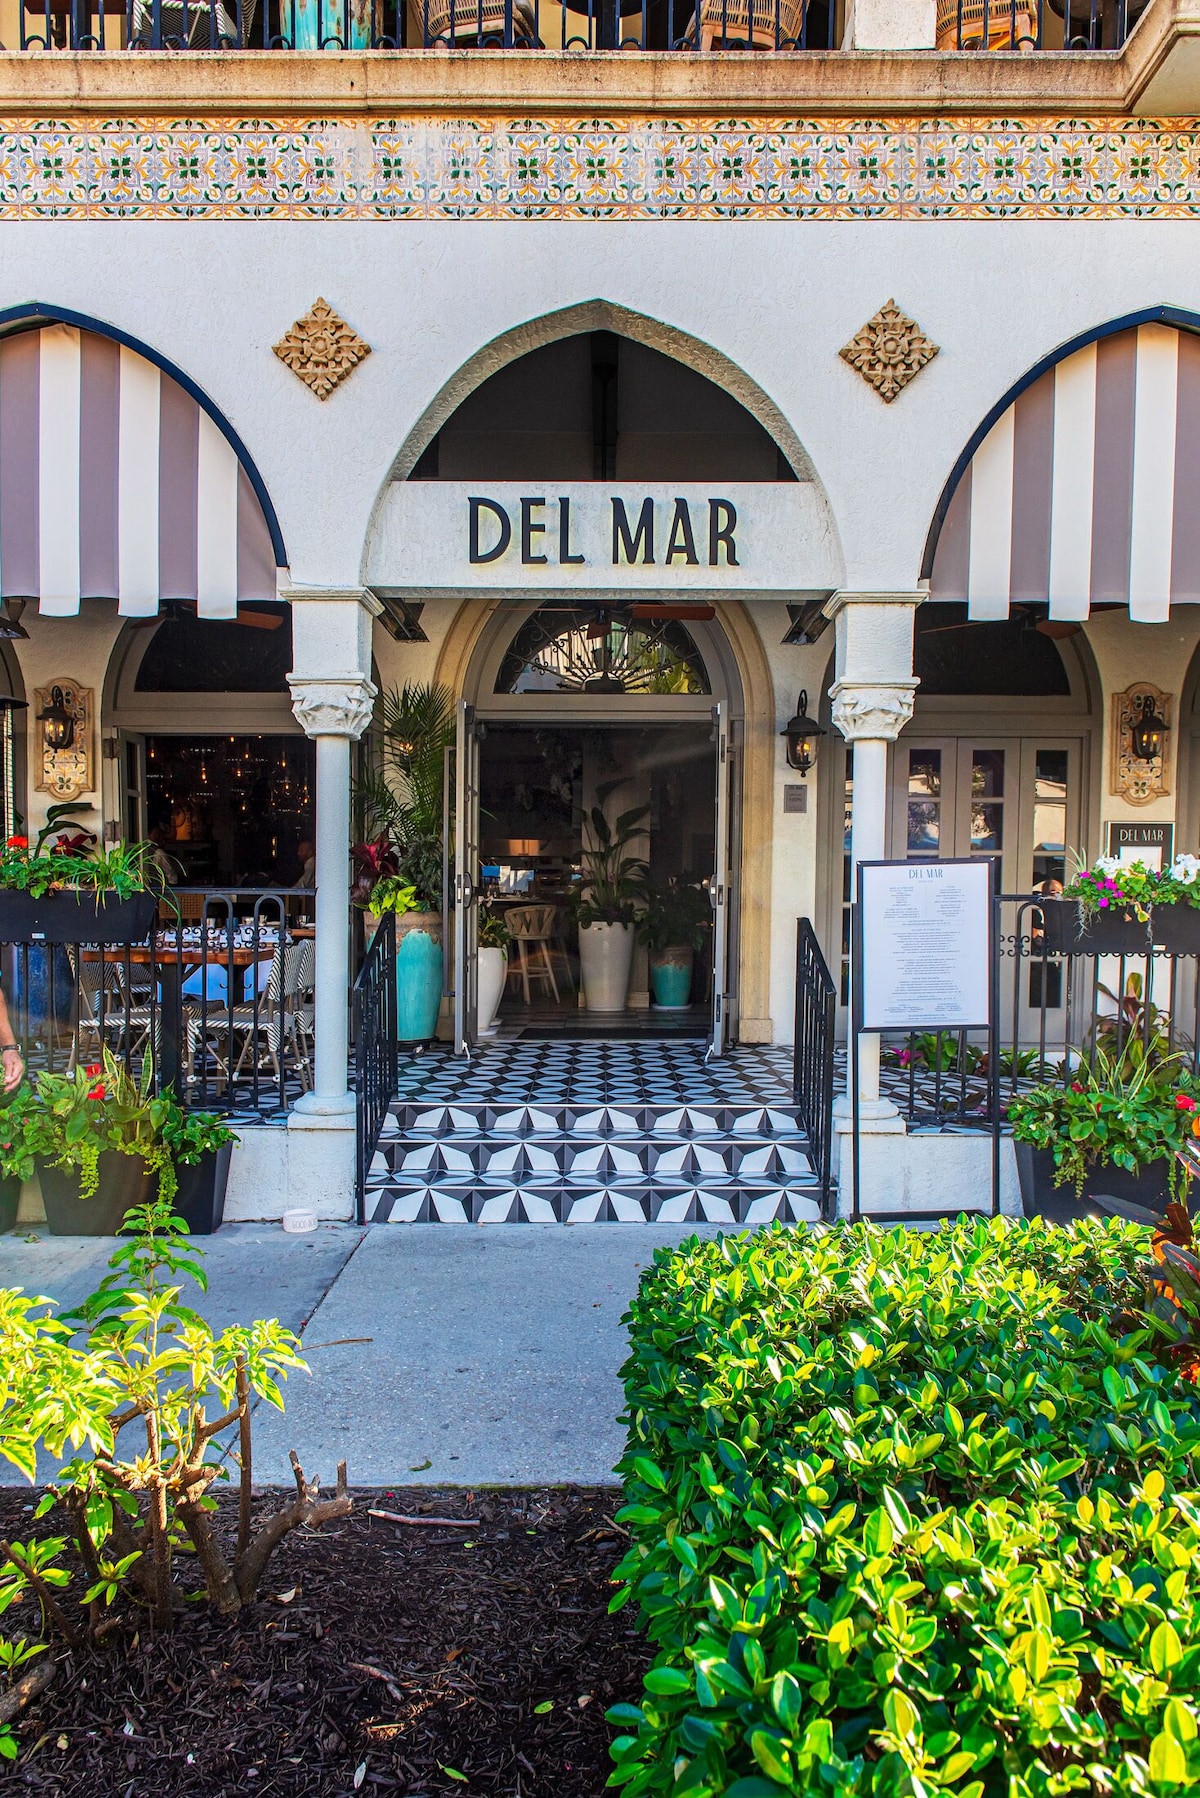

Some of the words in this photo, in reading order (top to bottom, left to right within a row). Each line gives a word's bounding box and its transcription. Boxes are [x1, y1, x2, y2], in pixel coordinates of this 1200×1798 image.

[467, 496, 586, 565] DEL
[610, 496, 740, 566] MAR
[1119, 828, 1139, 842] DEL
[1142, 828, 1164, 842] MAR
[908, 868, 923, 879] DEL
[926, 868, 943, 879] MAR
